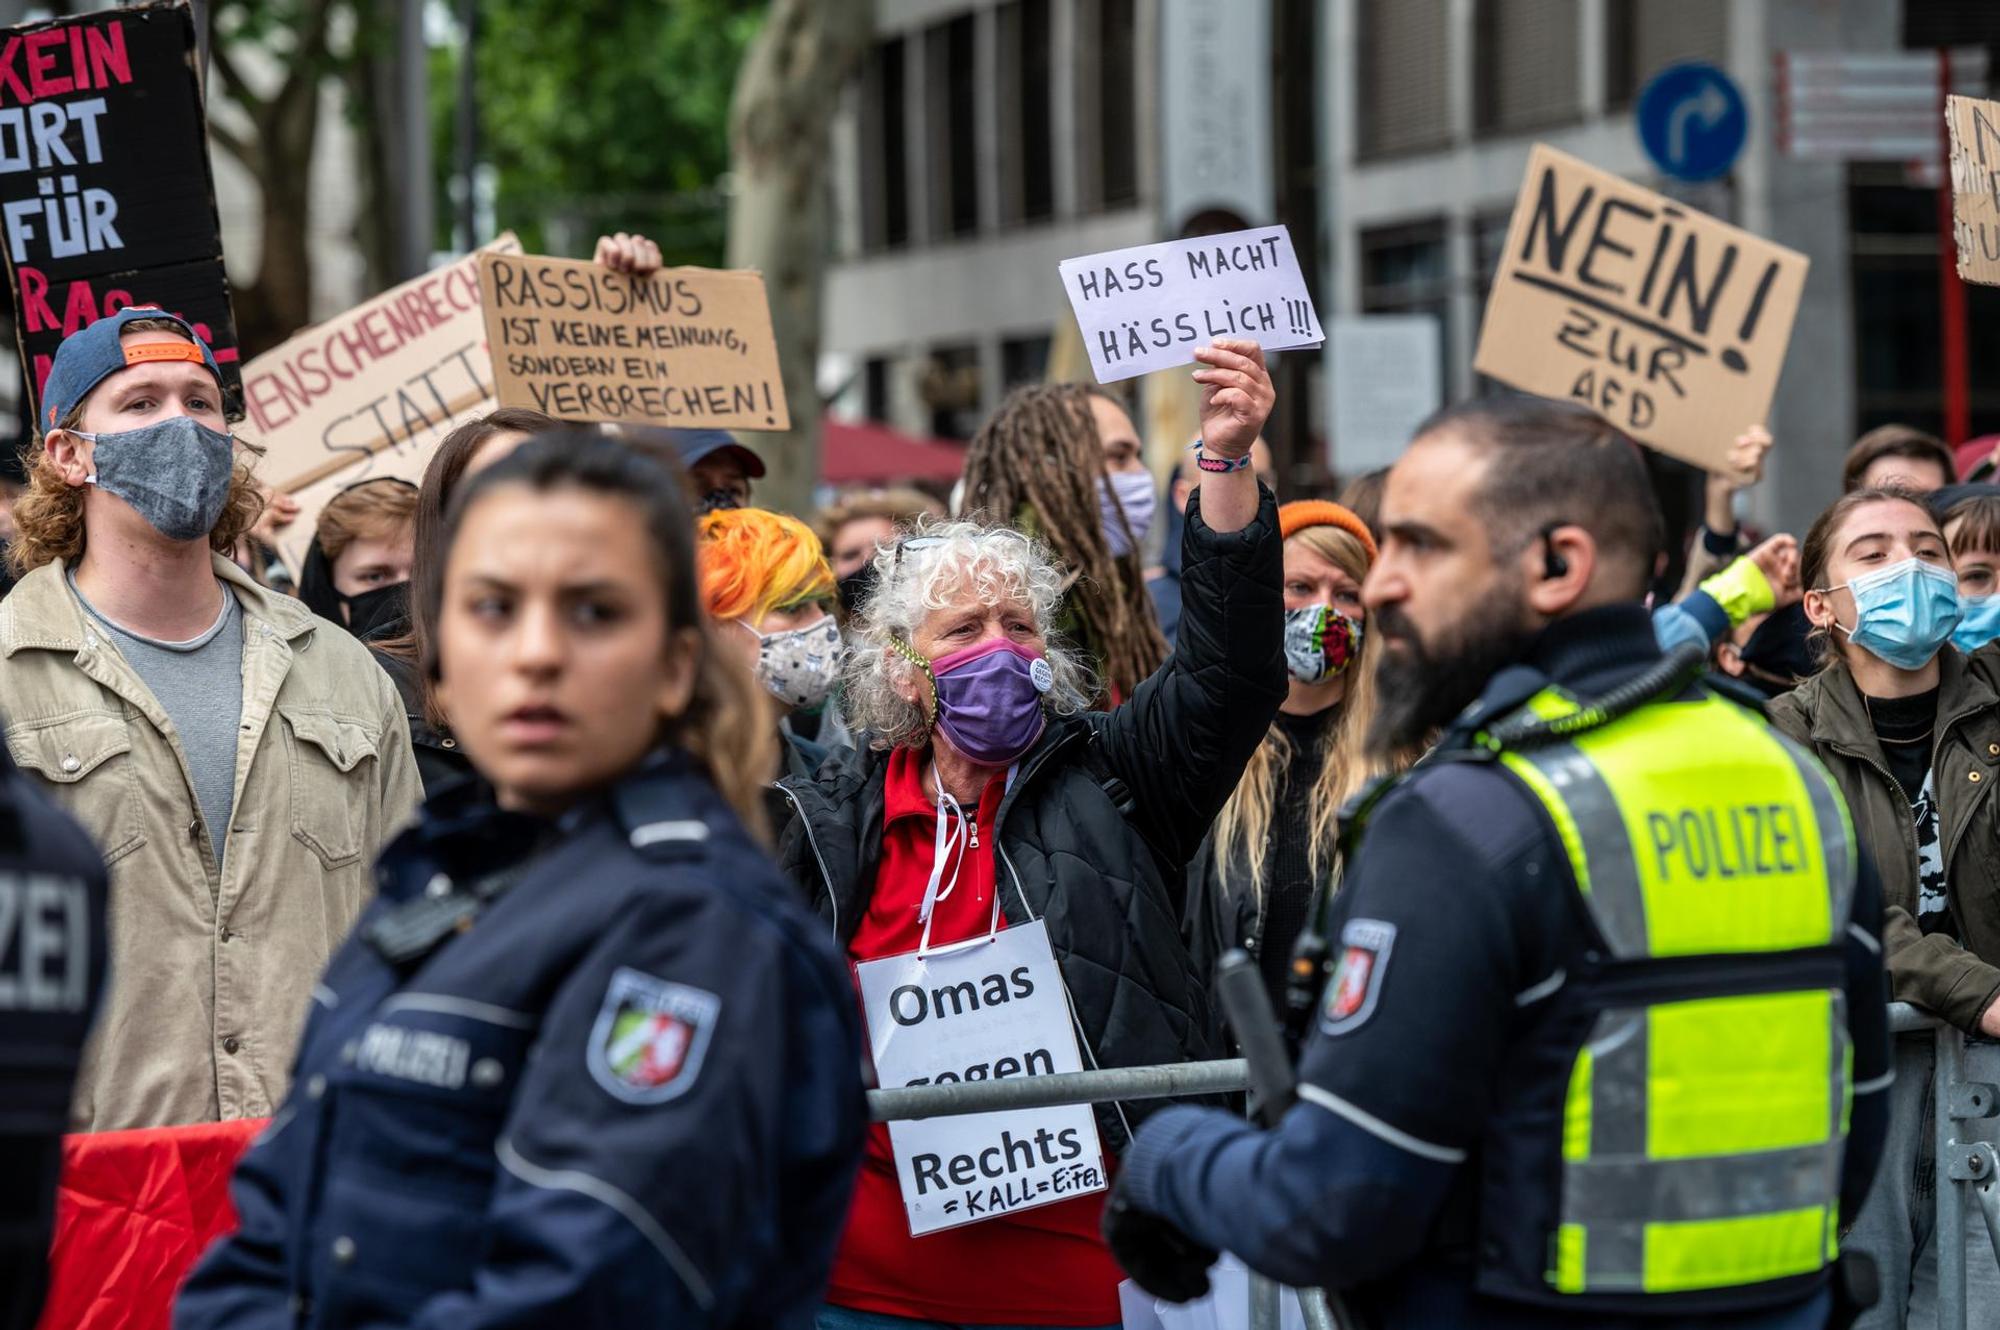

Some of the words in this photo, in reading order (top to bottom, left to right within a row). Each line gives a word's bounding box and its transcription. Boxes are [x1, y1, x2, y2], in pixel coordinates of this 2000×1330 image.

[0, 21, 132, 104] KEIN
[0, 98, 107, 173] ORT
[4, 174, 125, 263] FÜR
[491, 261, 702, 317] RASSISMUS
[1078, 260, 1164, 300] HASS
[1187, 236, 1280, 279] MACHT
[501, 317, 540, 346] IST
[551, 320, 632, 348] KEINE
[636, 328, 748, 355] MEINUNG,
[507, 355, 615, 377] SONDERN
[623, 357, 668, 379] EIN
[1556, 307, 1687, 398] ZUR
[322, 341, 491, 488] STATT
[528, 380, 776, 425] VERBRECHEN!
[1647, 803, 1809, 881] POLIZEI
[889, 965, 1035, 1027] Omas
[911, 1127, 1082, 1195] Rechts
